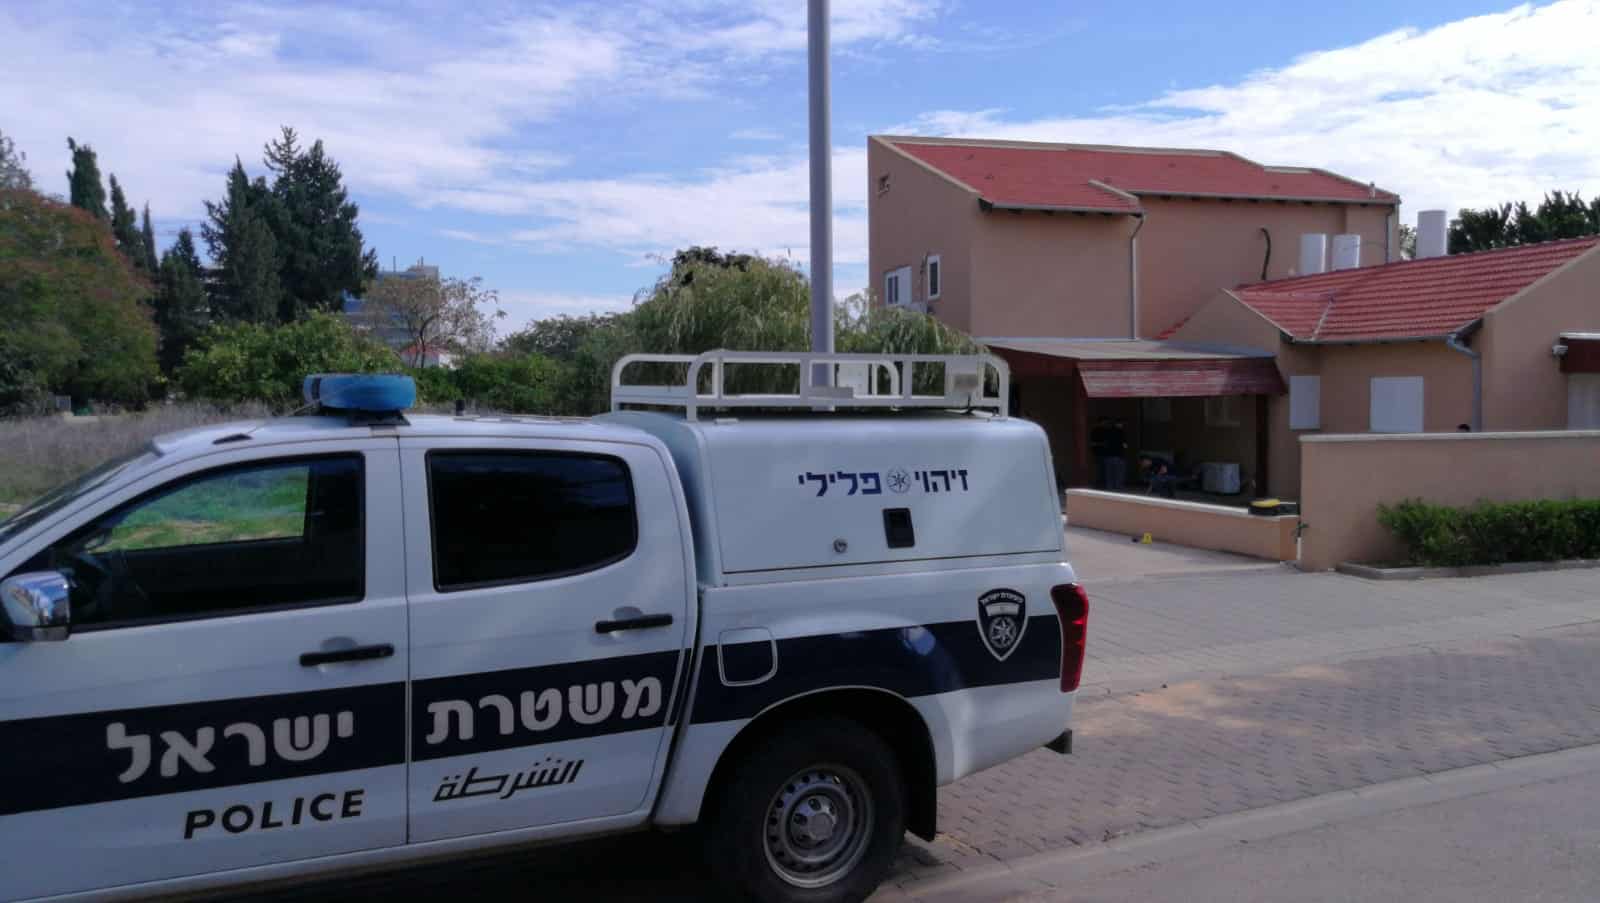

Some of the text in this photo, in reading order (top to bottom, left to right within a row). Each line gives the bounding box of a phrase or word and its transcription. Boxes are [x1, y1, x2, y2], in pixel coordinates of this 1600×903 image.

[798, 468, 969, 497] זיהוי פלילי
[105, 675, 662, 784] משטרת ישראל
[431, 756, 585, 802] الشرطة
[183, 788, 365, 840] POLICE
